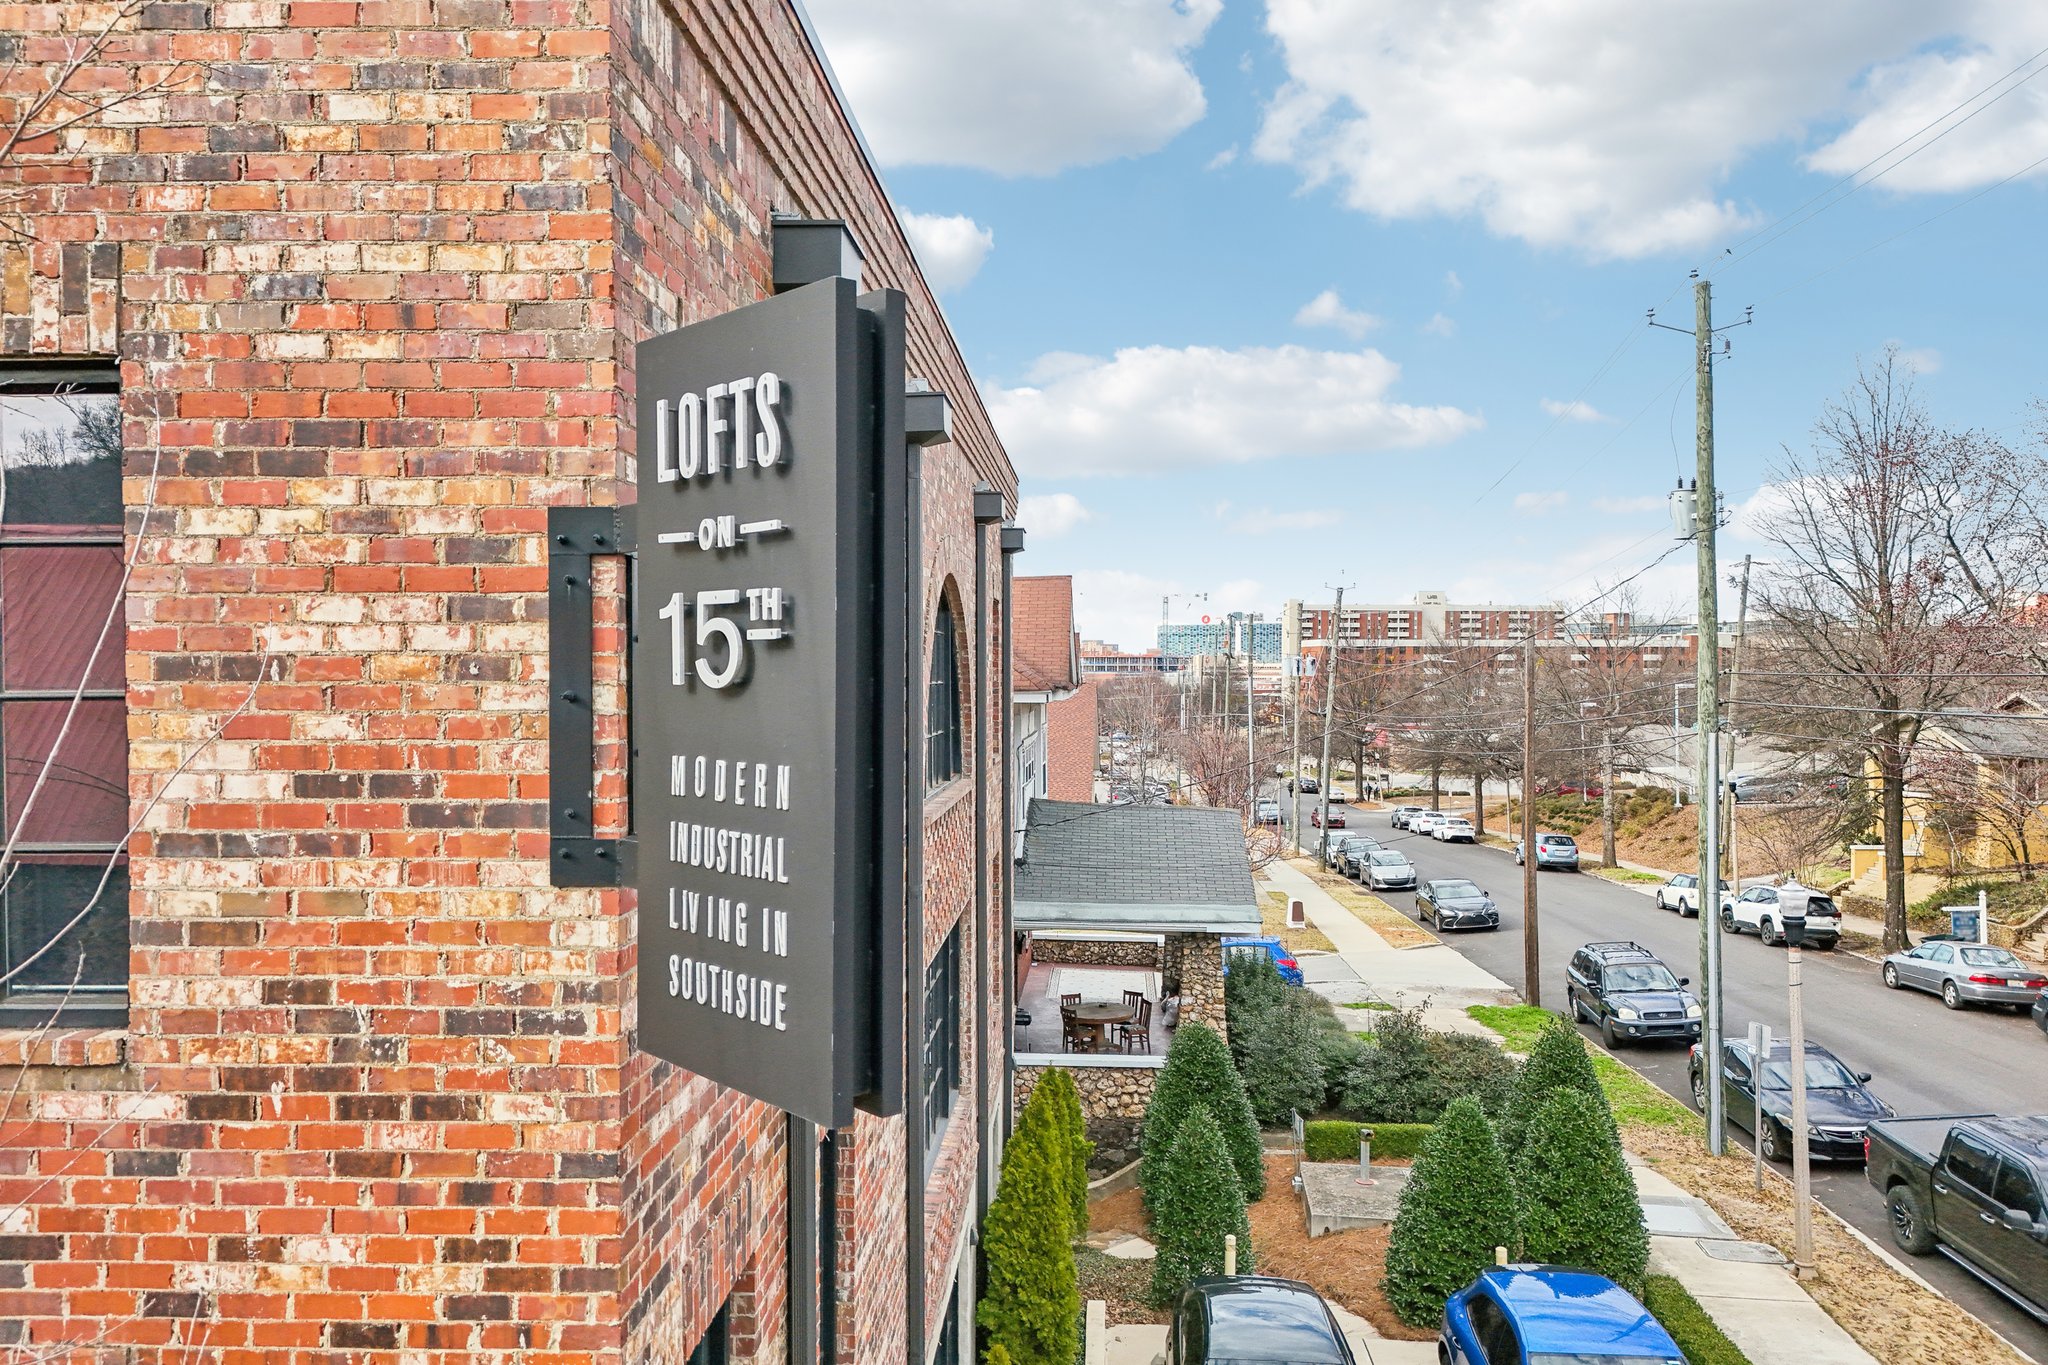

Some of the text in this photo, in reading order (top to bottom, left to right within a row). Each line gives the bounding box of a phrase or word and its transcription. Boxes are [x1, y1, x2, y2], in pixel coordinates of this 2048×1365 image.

[657, 371, 781, 483] LOFTS
[671, 755, 791, 811] MODERN
[669, 821, 789, 883] INDUSTRIAL
[669, 887, 788, 957] LIVING IN
[668, 954, 787, 1031] SOUTHSIDE
